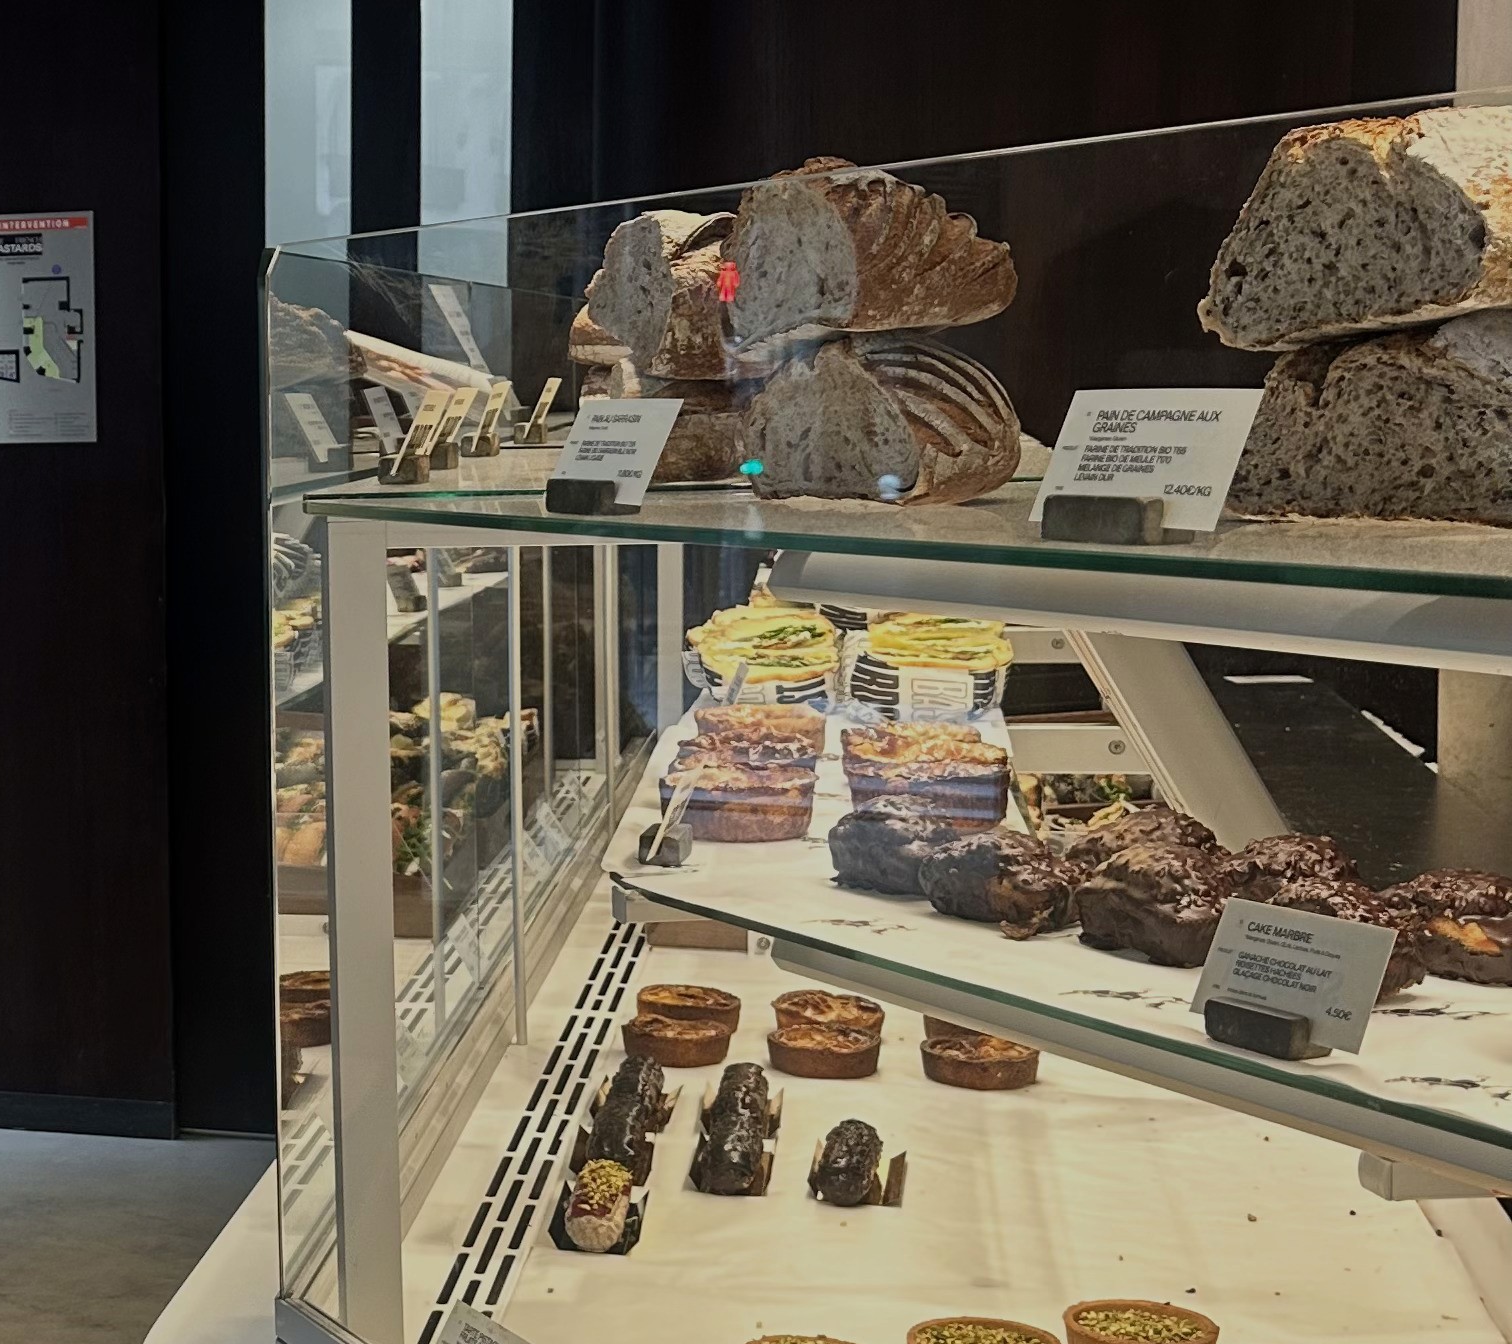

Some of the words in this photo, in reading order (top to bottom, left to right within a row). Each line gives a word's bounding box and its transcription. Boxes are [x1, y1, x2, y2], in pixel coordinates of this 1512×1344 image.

[1096, 409, 1120, 421] PAIN
[1120, 409, 1136, 421] DE
[1136, 409, 1197, 422] CAMPAGNE
[1196, 410, 1222, 422] AUX
[1093, 421, 1137, 433] GRAINES
[1247, 921, 1273, 936] CAKE
[1272, 926, 1315, 944] MARBRE
